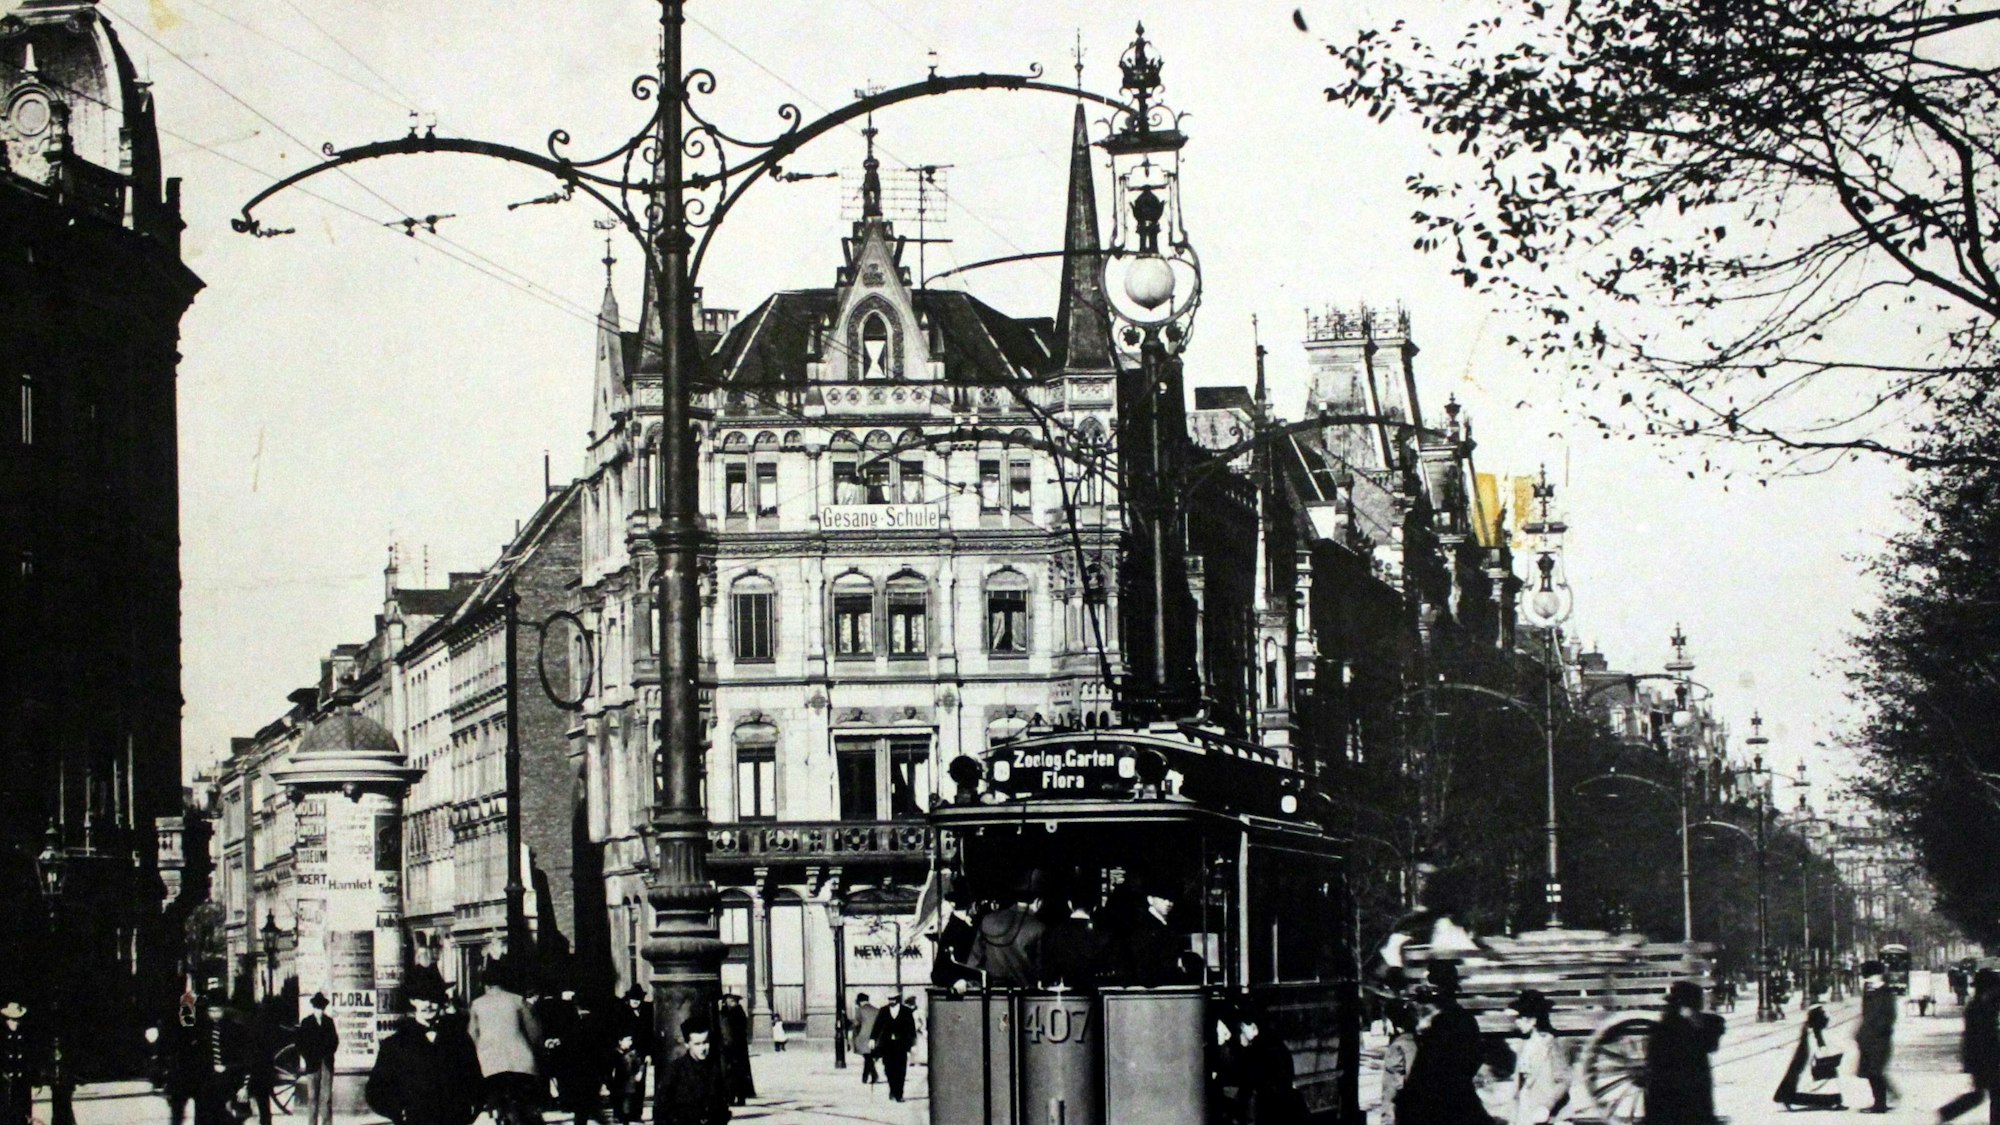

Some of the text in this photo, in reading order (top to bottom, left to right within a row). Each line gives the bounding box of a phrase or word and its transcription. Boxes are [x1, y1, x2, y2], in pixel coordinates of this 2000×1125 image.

[1042, 771, 1085, 789] Flora
[328, 879, 373, 890] Hamlet
[331, 992, 374, 1006] FLORA
[1023, 1005, 1090, 1044] 407
